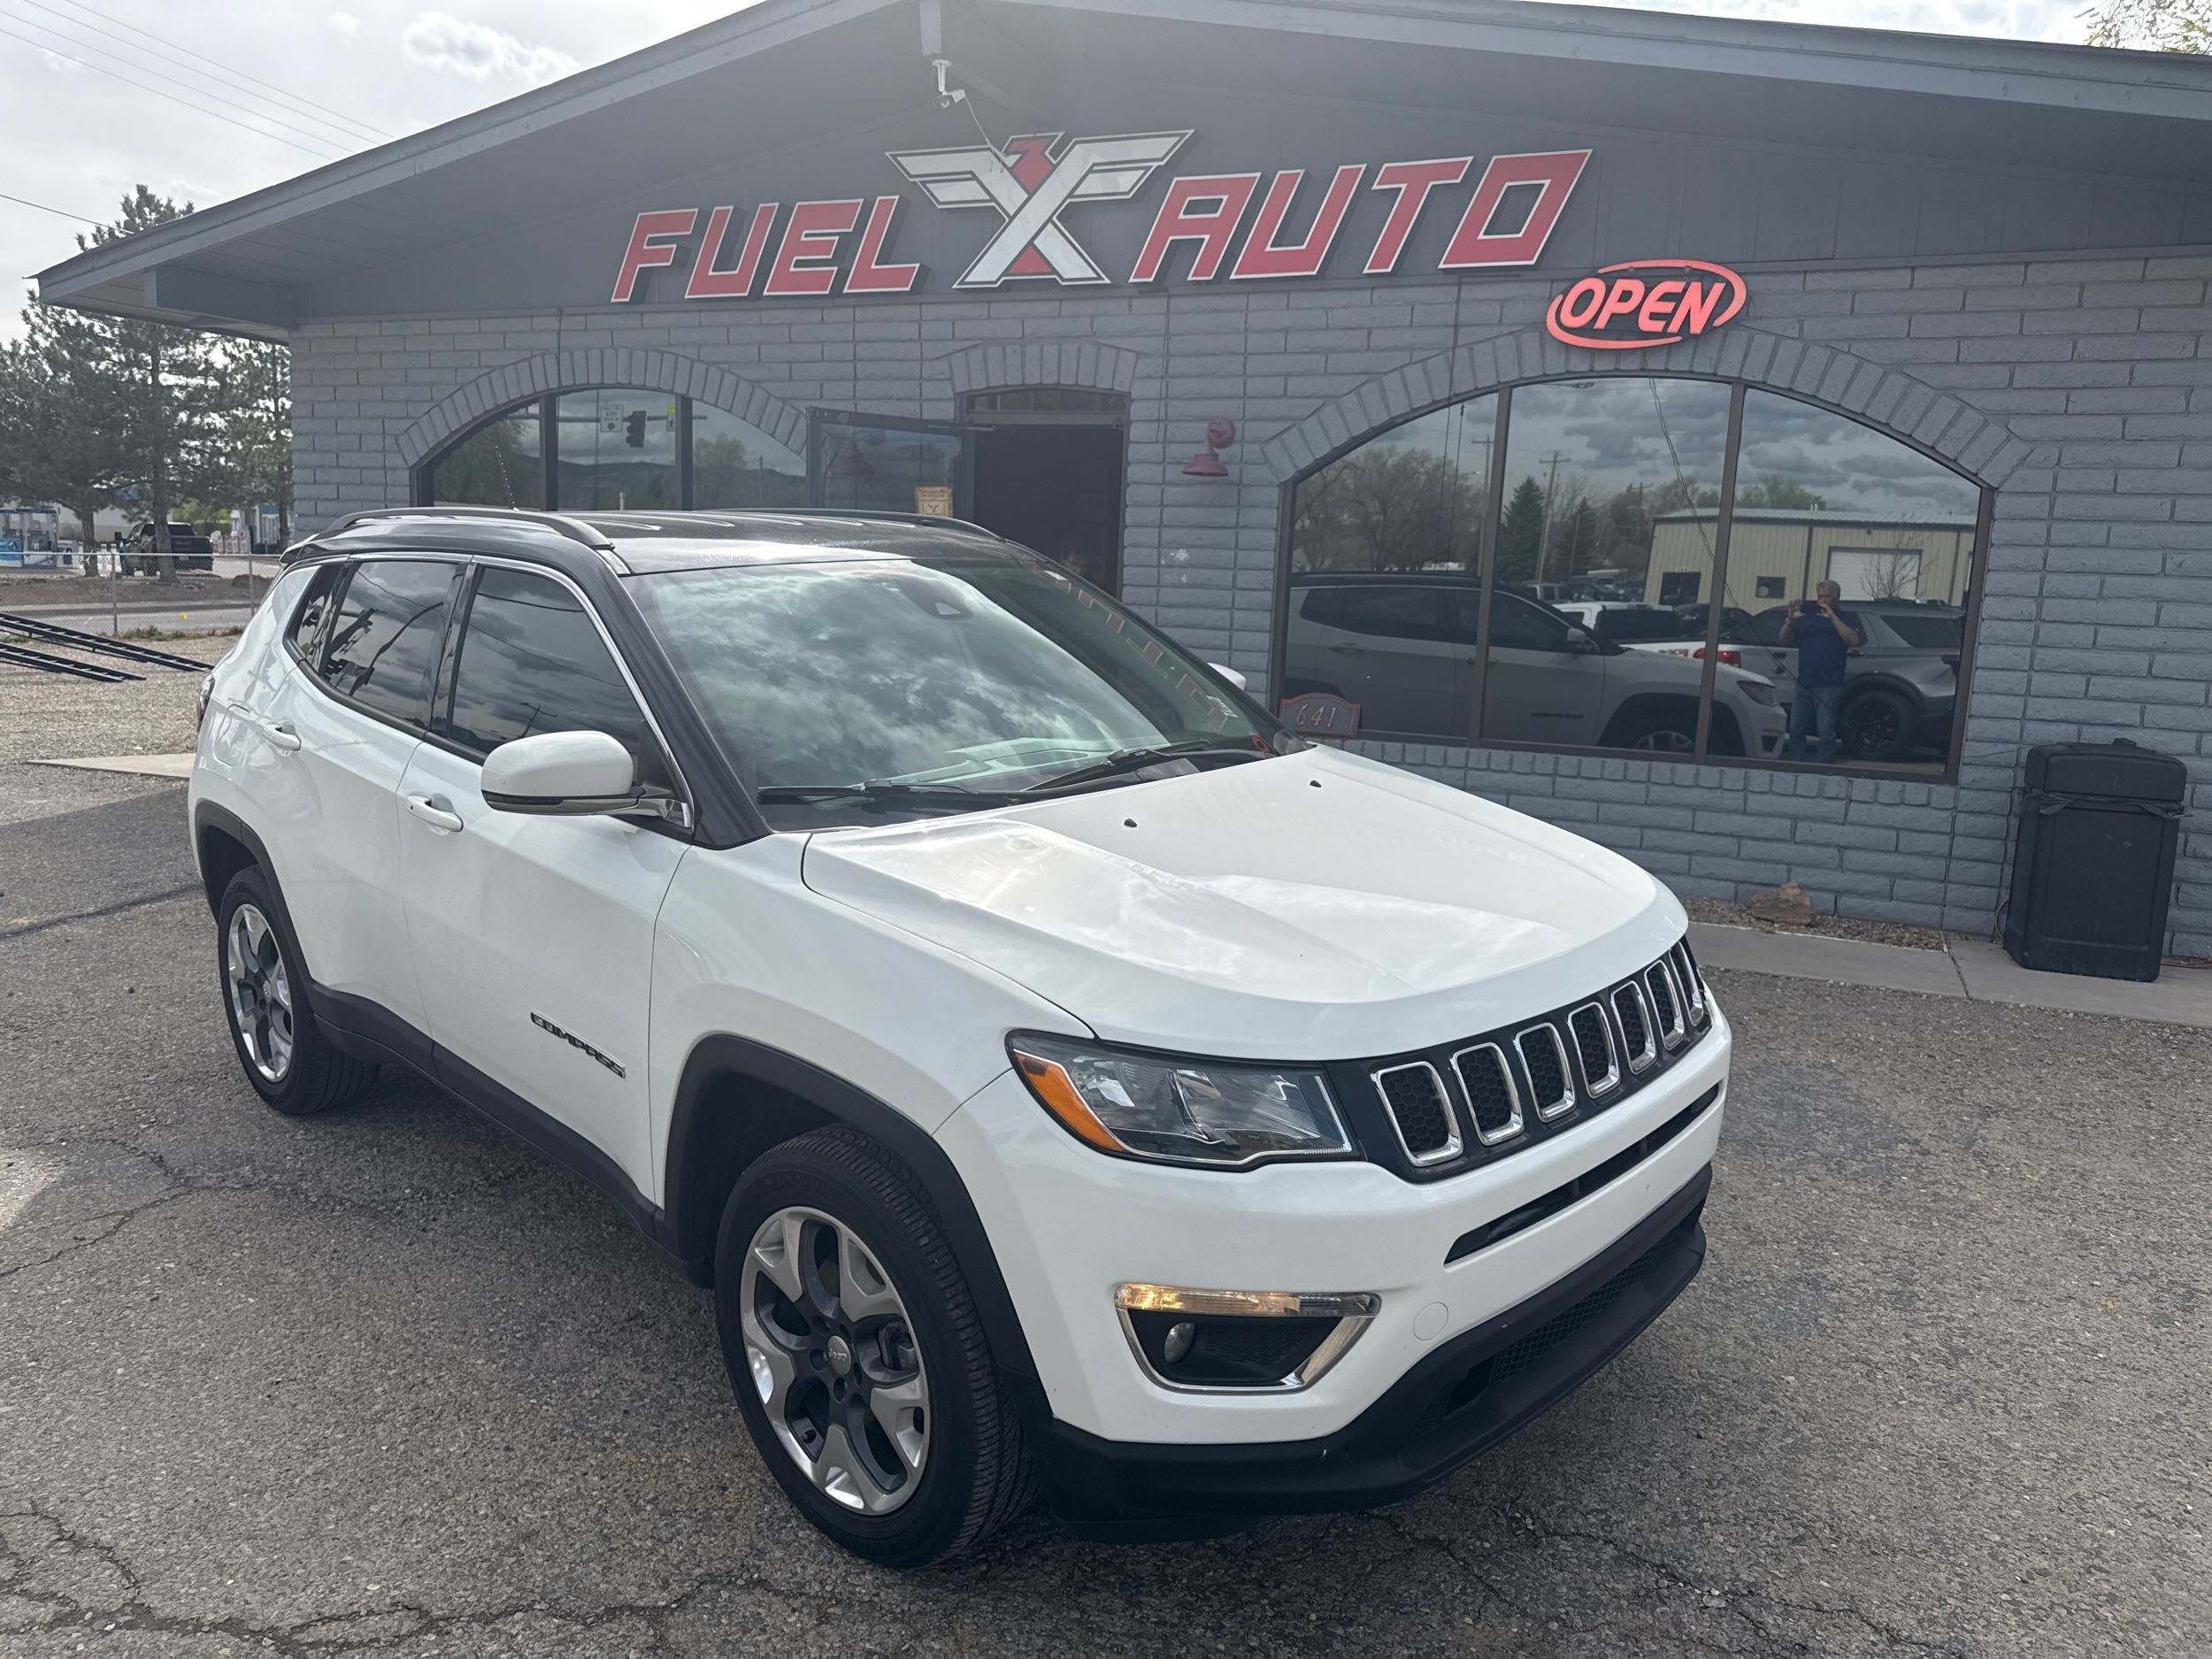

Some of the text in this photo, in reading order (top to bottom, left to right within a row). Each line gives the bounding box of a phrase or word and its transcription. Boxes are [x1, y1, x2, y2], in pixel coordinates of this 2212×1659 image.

[611, 195, 920, 302] FUEL
[1128, 149, 1592, 282] AUTO
[1560, 277, 1725, 334] OPEN
[1296, 703, 1336, 727] 641
[531, 1010, 626, 1079] COMPASS
